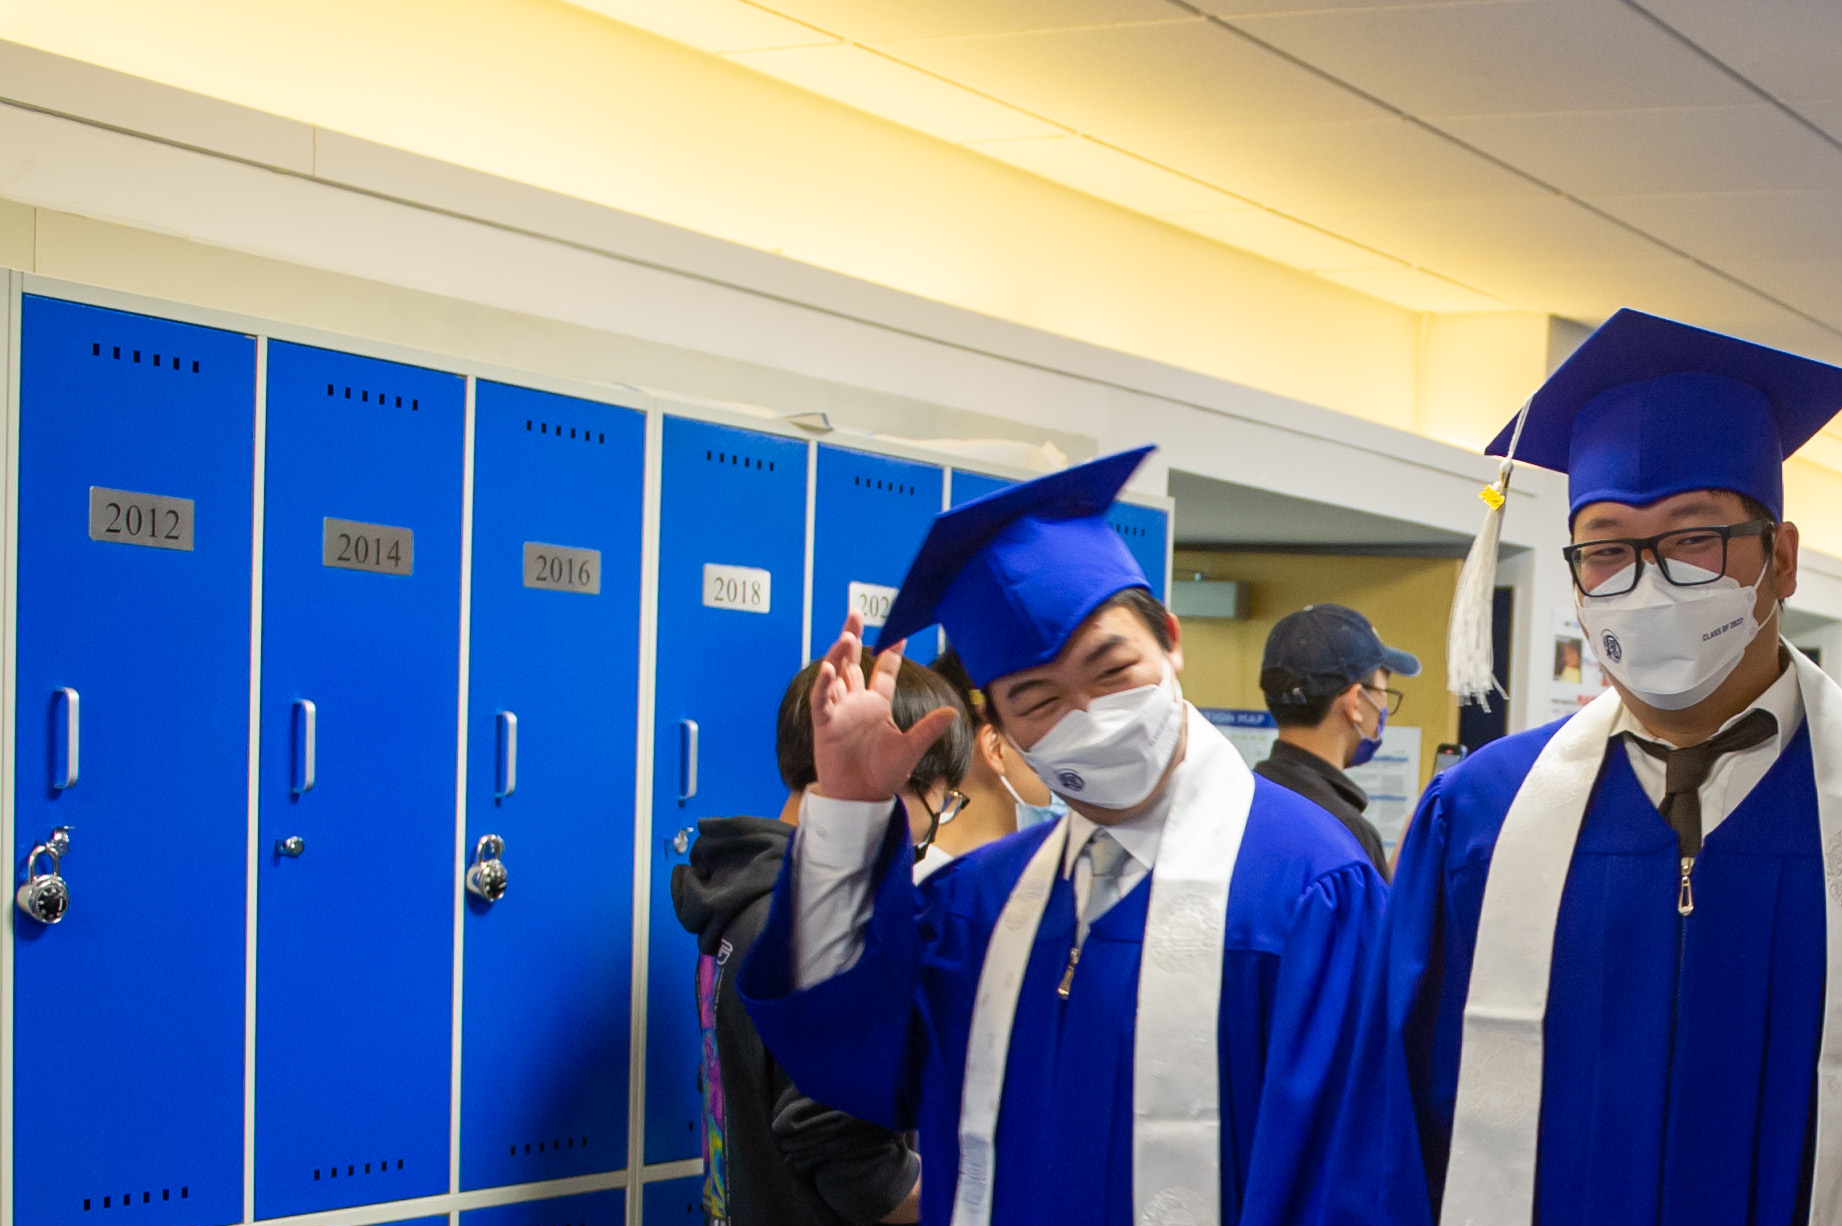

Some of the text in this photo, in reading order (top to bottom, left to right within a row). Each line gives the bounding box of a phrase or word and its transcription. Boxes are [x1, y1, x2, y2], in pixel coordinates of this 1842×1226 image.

[105, 502, 180, 540] 2012
[337, 533, 402, 567] 2014
[535, 554, 591, 586] 2016
[713, 576, 762, 605] 2018
[858, 593, 890, 619] 202
[1703, 628, 1721, 641] CLASS
